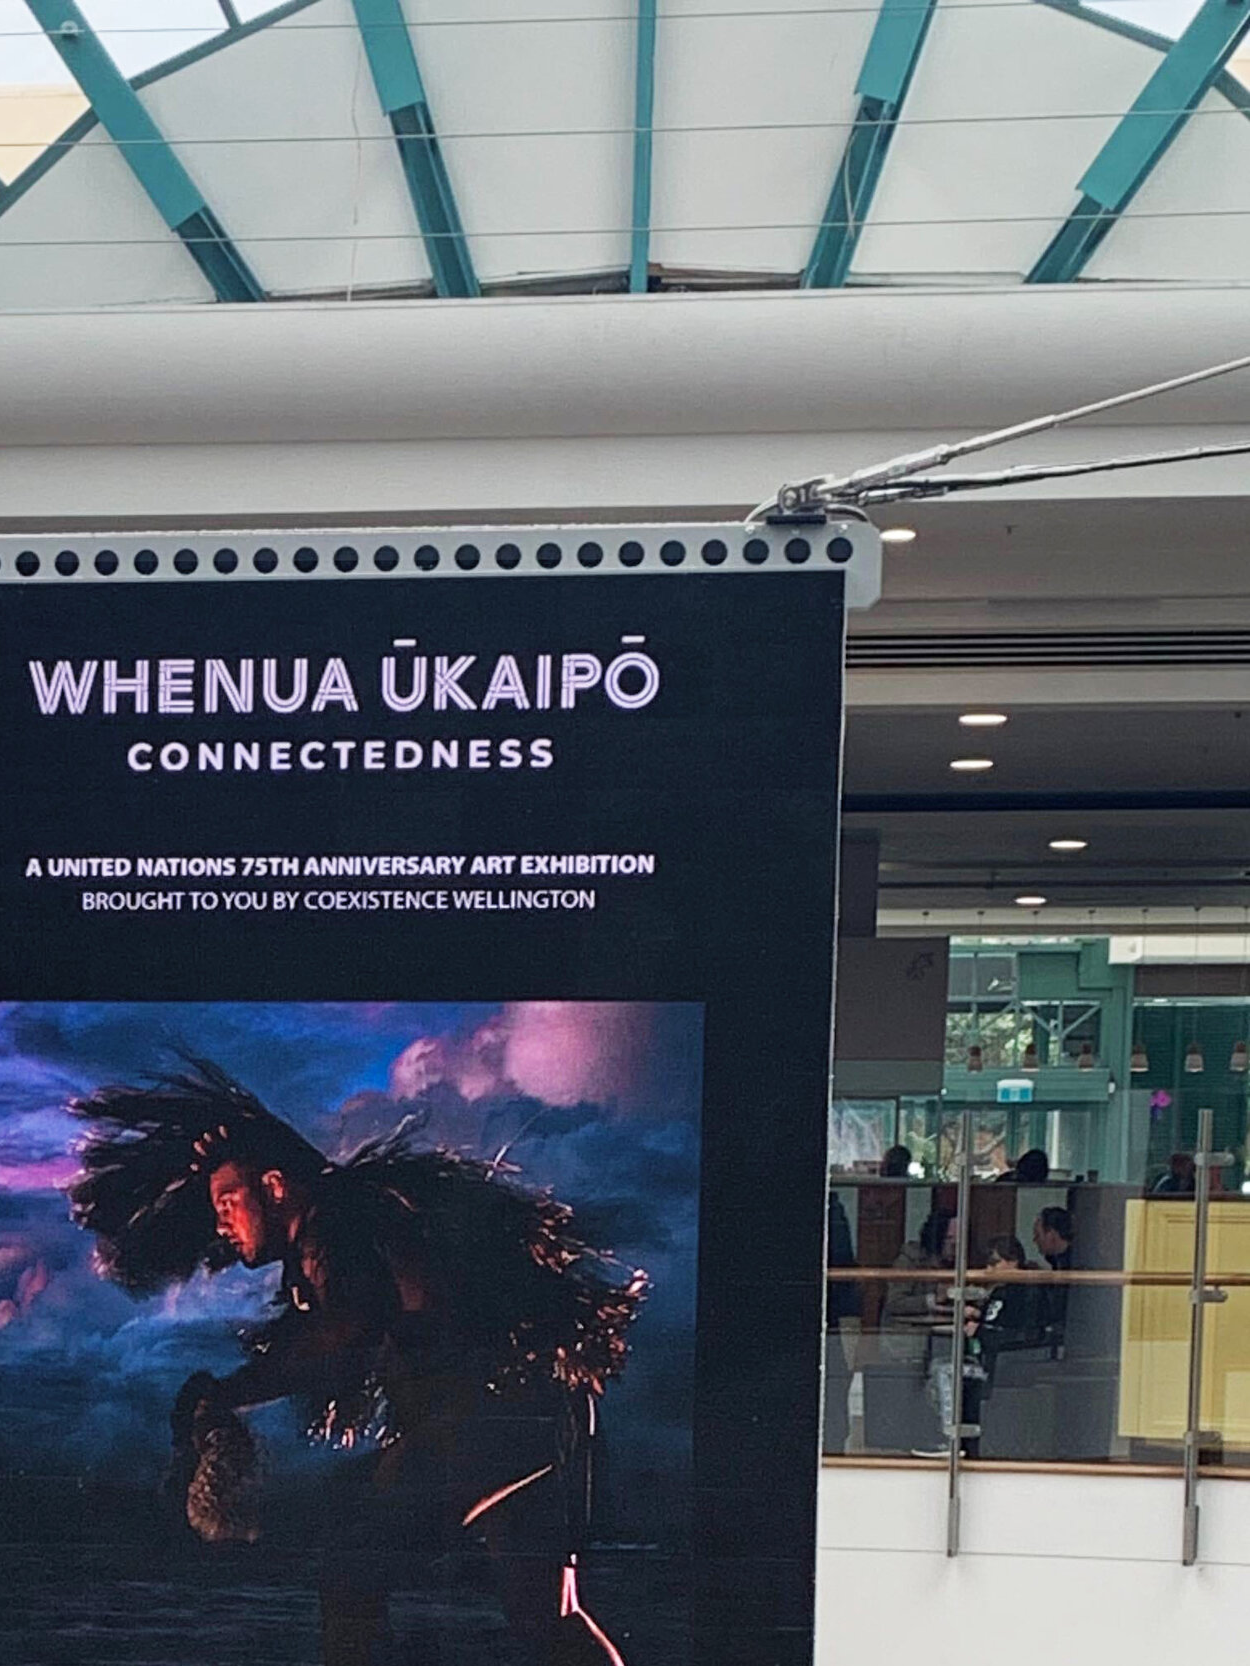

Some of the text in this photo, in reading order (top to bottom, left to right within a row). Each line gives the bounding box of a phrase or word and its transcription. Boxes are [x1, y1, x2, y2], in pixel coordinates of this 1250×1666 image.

[29, 636, 659, 714] WHENUA ŪKAIPŌ
[128, 739, 553, 771] CONNECTEDNESS
[26, 855, 654, 877] A UNITED NATIONS 75TH ANNIVERSARY ART EXHIBITION
[83, 890, 595, 910] BROUGHT TO YOU BY COEXISTENCE WELLINGTON
